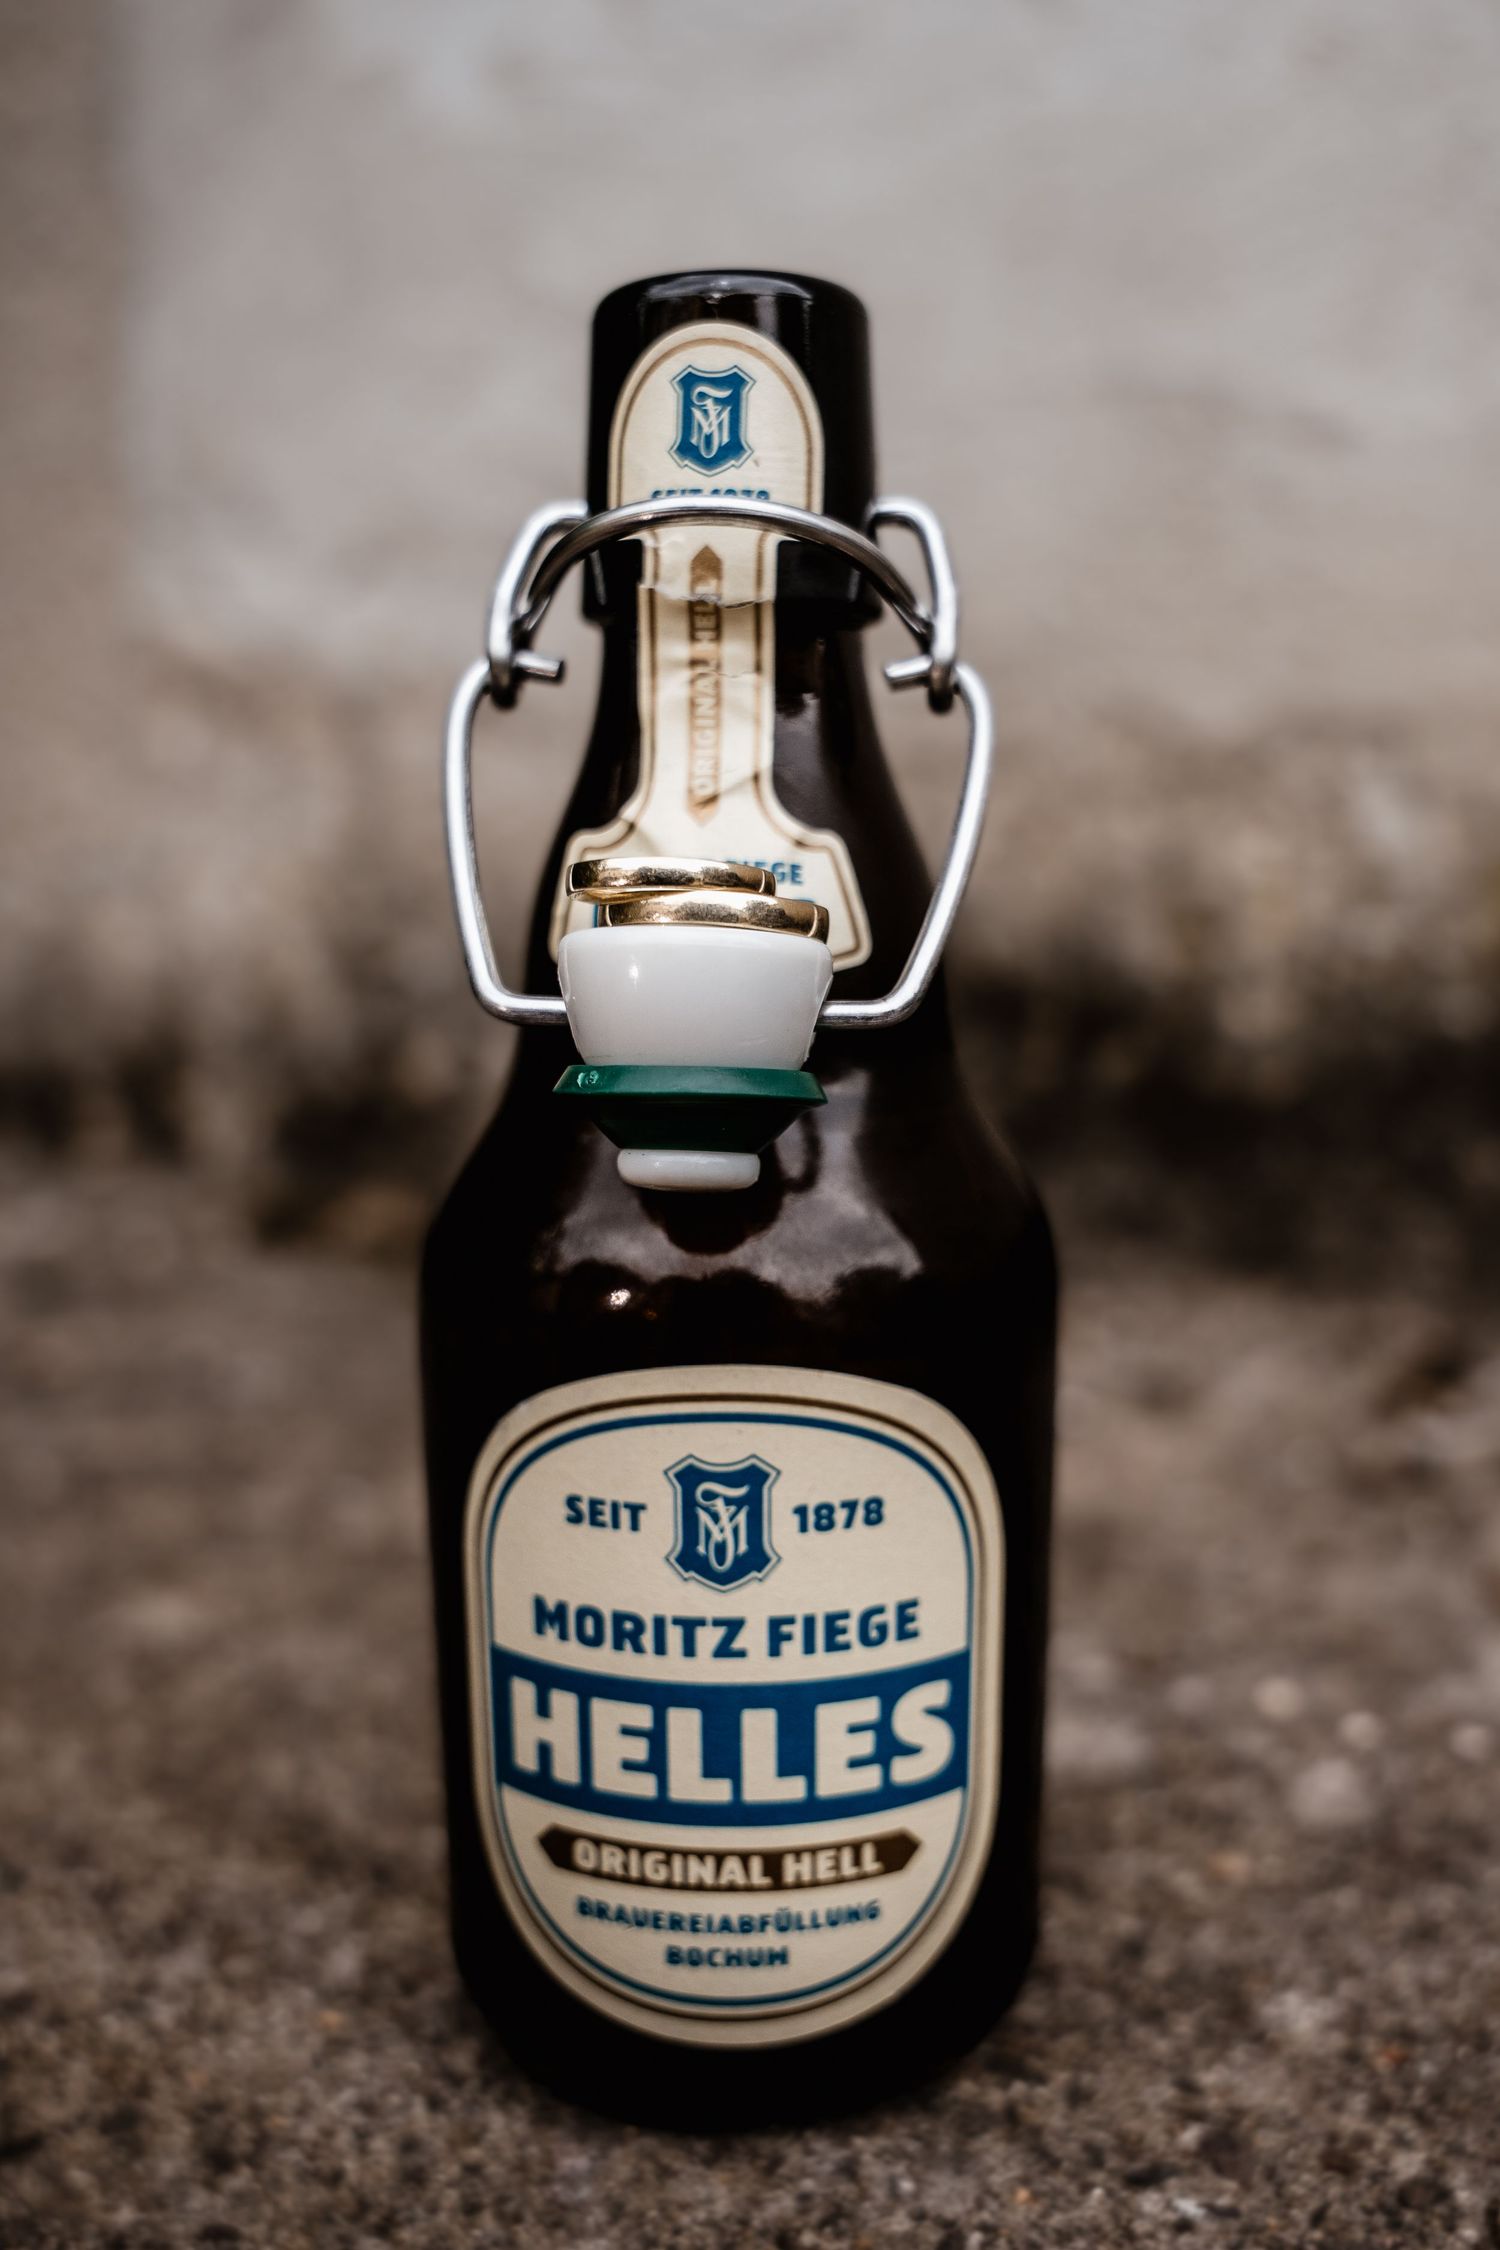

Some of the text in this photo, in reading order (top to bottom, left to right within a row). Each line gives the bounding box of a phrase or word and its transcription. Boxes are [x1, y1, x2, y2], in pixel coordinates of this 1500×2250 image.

[564, 1494, 884, 1533] SEIT 1878
[532, 1594, 921, 1659] MORITZ FIEGE
[509, 1678, 955, 1804] HELLES
[571, 1836, 884, 1887] ORIGINAL HELL
[576, 1895, 881, 1934] BRAUEREIABFÜLLUNG
[664, 1945, 790, 1968] BOCHUM
